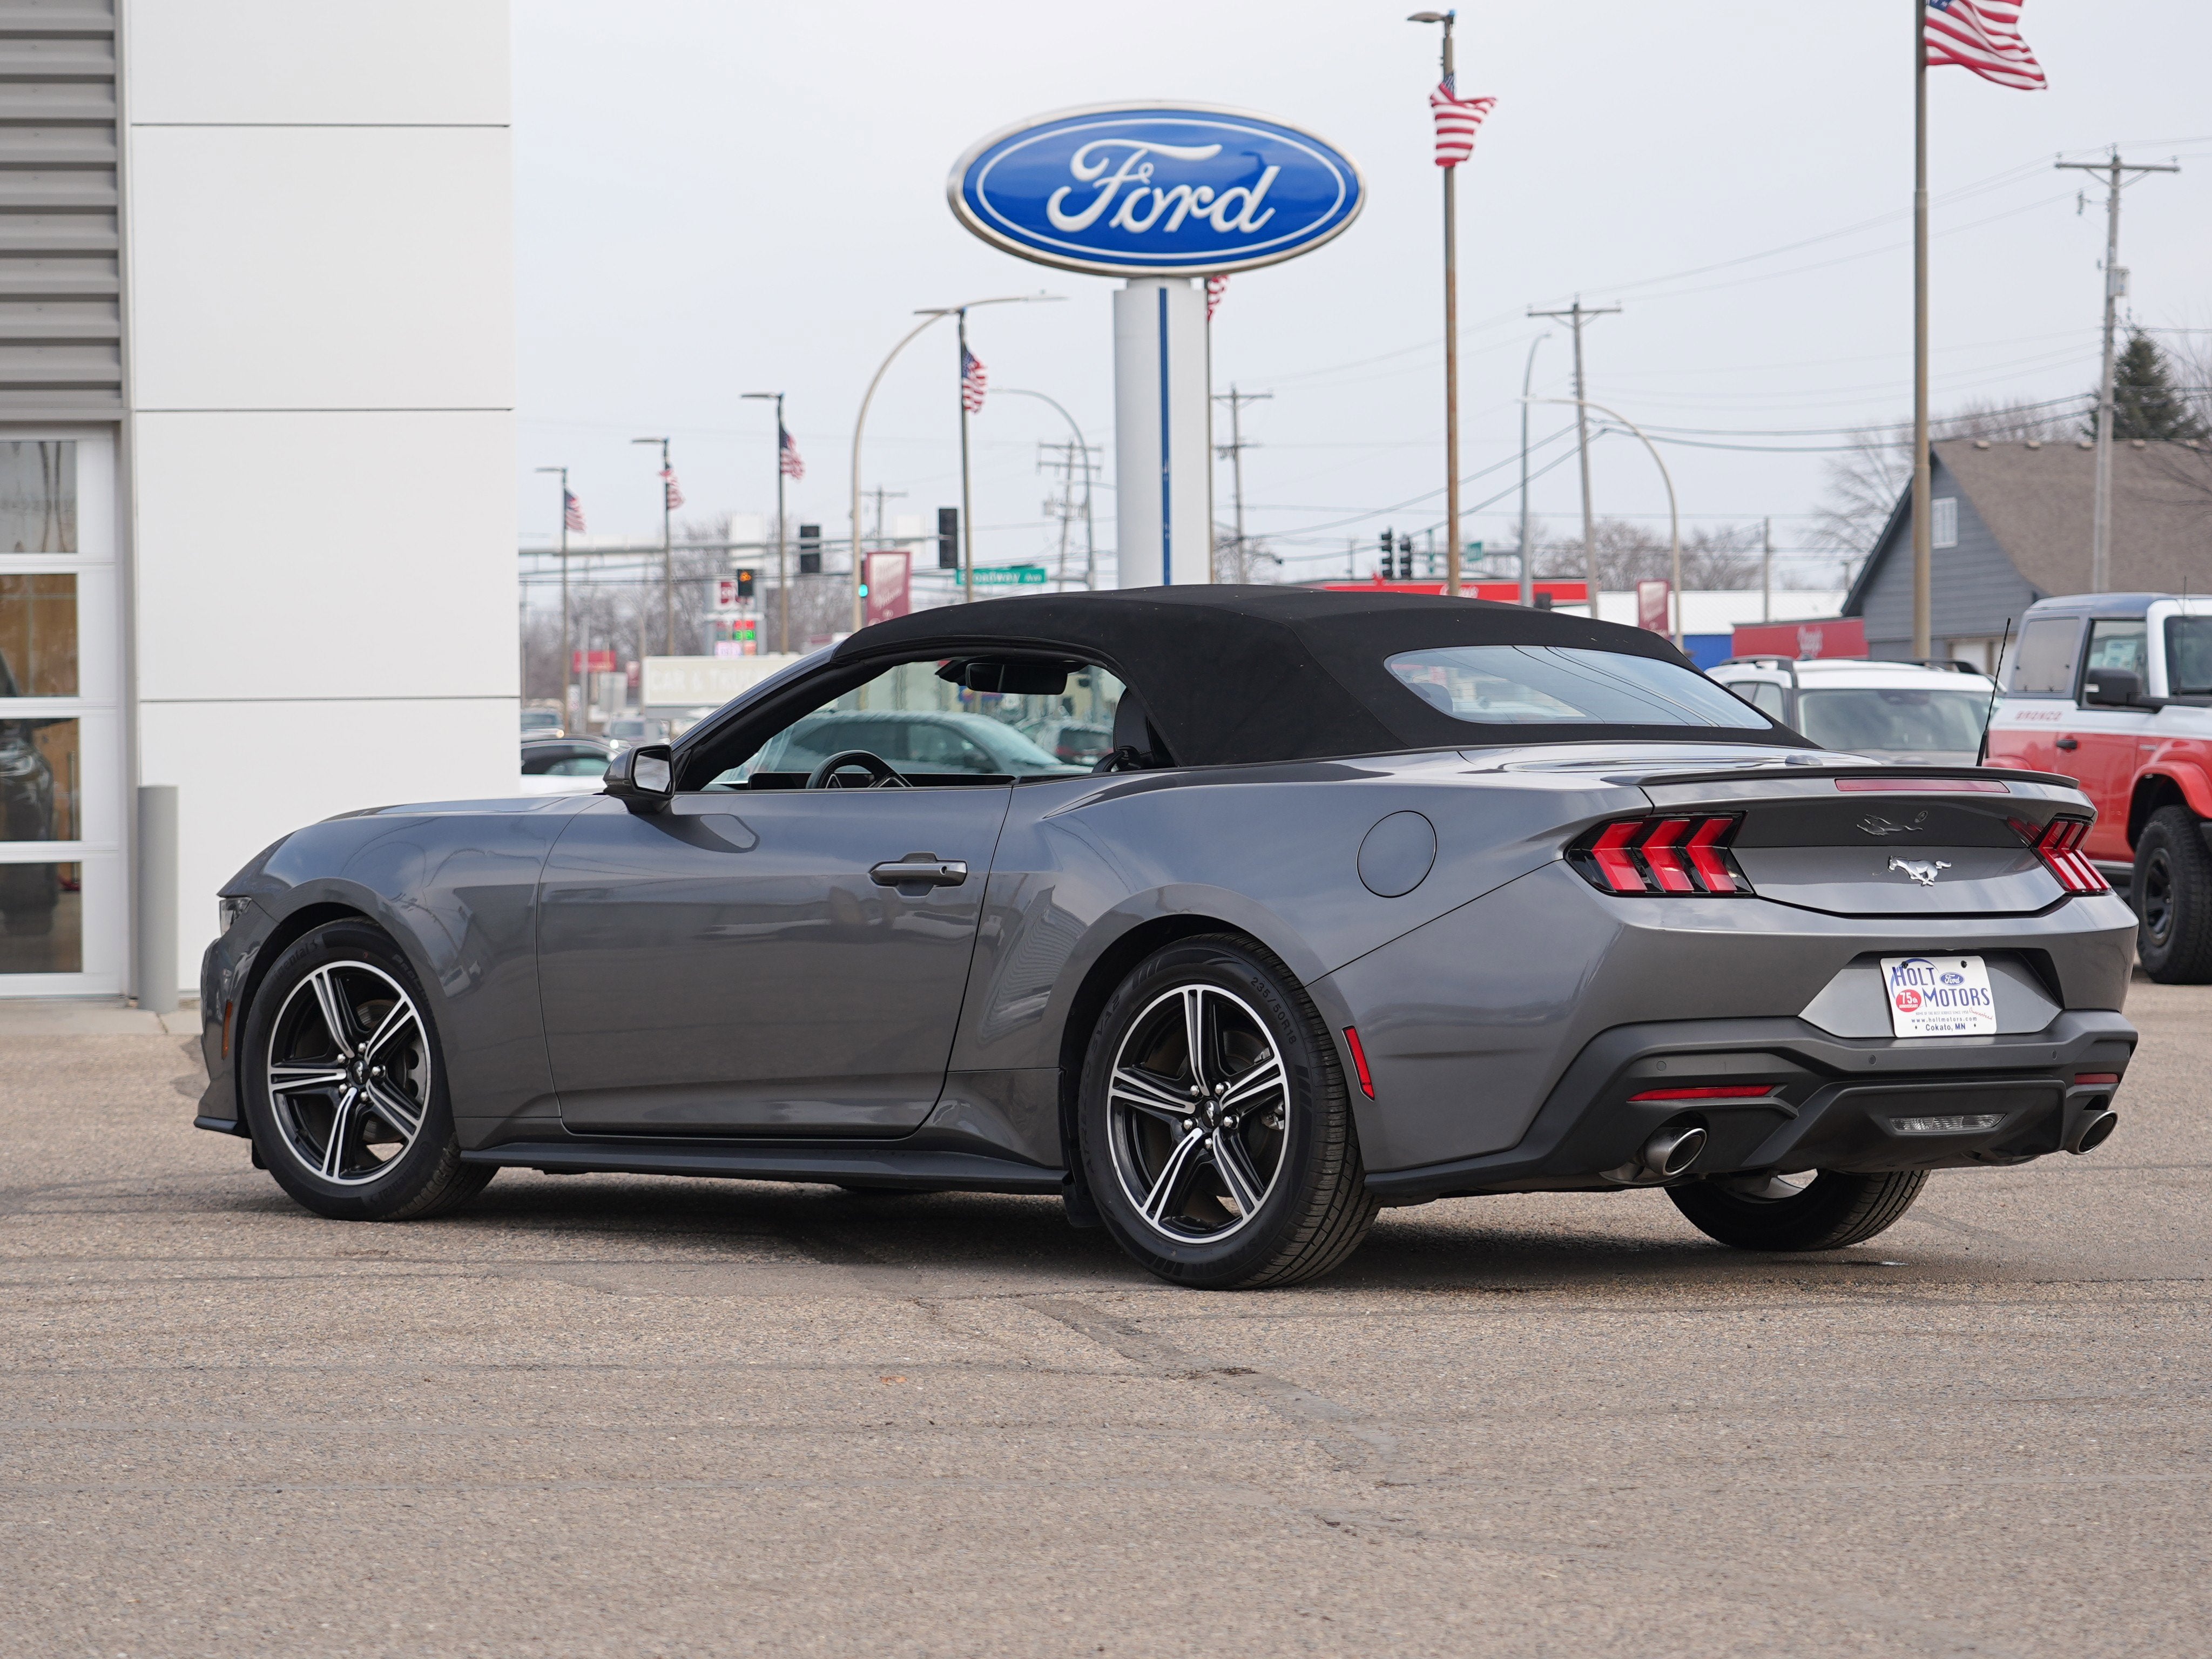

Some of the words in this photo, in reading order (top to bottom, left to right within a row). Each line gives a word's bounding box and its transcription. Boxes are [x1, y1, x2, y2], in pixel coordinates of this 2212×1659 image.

[1046, 138, 1281, 233] Ford
[959, 570, 1020, 583] Boadway
[1892, 967, 1936, 986] HOLT
[1944, 973, 1960, 984] Ford
[1899, 992, 1918, 1004] 75th
[1922, 987, 1991, 1007] MOTORS
[1251, 976, 1297, 1045] 235/50R18
[1926, 1023, 1953, 1031] Cokato,
